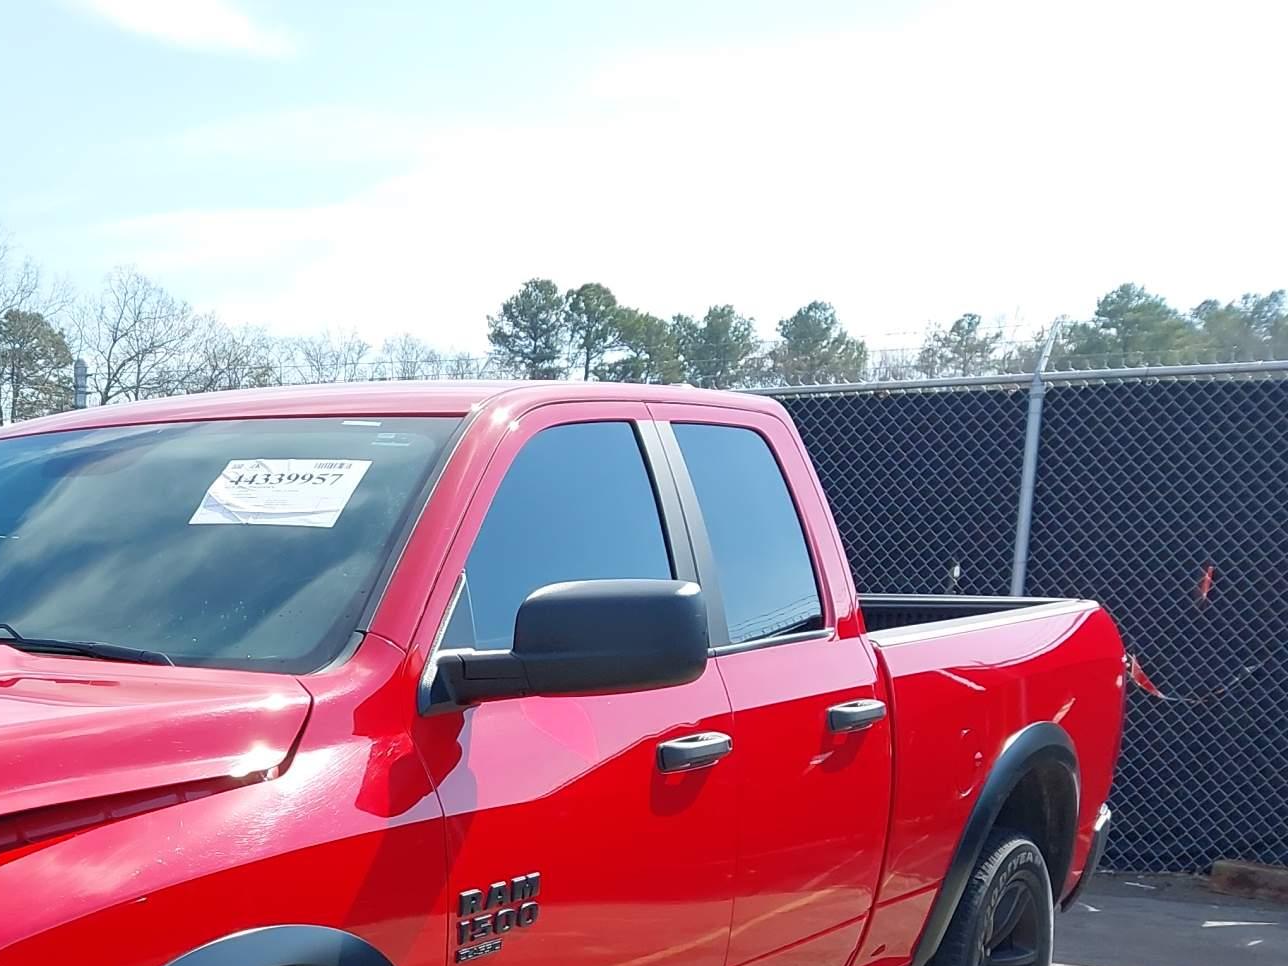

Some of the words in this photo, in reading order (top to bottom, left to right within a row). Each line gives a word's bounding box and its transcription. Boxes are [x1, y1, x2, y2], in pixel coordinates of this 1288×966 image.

[227, 472, 344, 487] 44339957
[456, 871, 541, 918] RAM
[456, 901, 540, 945] 1500
